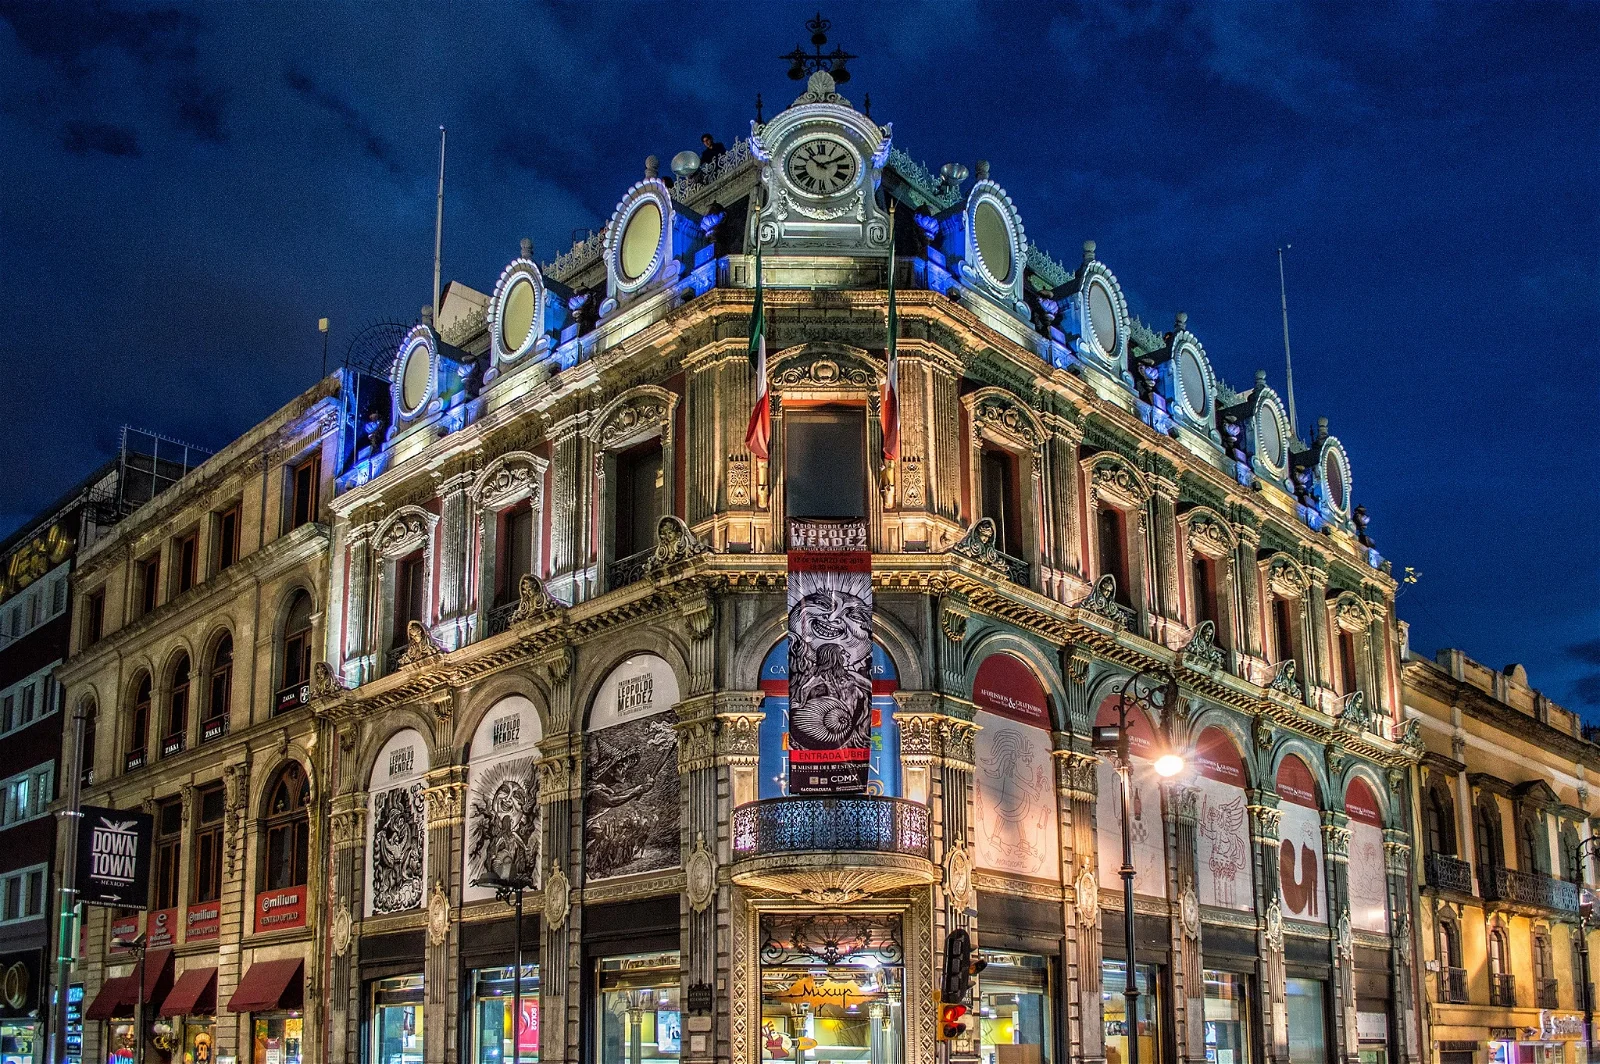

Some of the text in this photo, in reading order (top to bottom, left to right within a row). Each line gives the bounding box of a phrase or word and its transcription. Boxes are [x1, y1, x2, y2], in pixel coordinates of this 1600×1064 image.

[791, 527, 867, 539] LEOPOLDO
[791, 536, 867, 547] MENDEZ
[618, 679, 653, 699] LEOPOLDO
[618, 690, 653, 712] MENDEZ
[1008, 697, 1016, 709] &
[494, 718, 520, 735] LEOPOLDO
[493, 729, 520, 746] MENDEZ
[390, 750, 414, 766] LEOPOLDO
[799, 751, 868, 760] ENTRADA LIBRE
[389, 759, 413, 776] MENDEZ
[830, 774, 858, 782] CDMX
[92, 831, 138, 857] DOWN
[92, 852, 137, 878] TOWN
[802, 983, 852, 1008] Mixup
